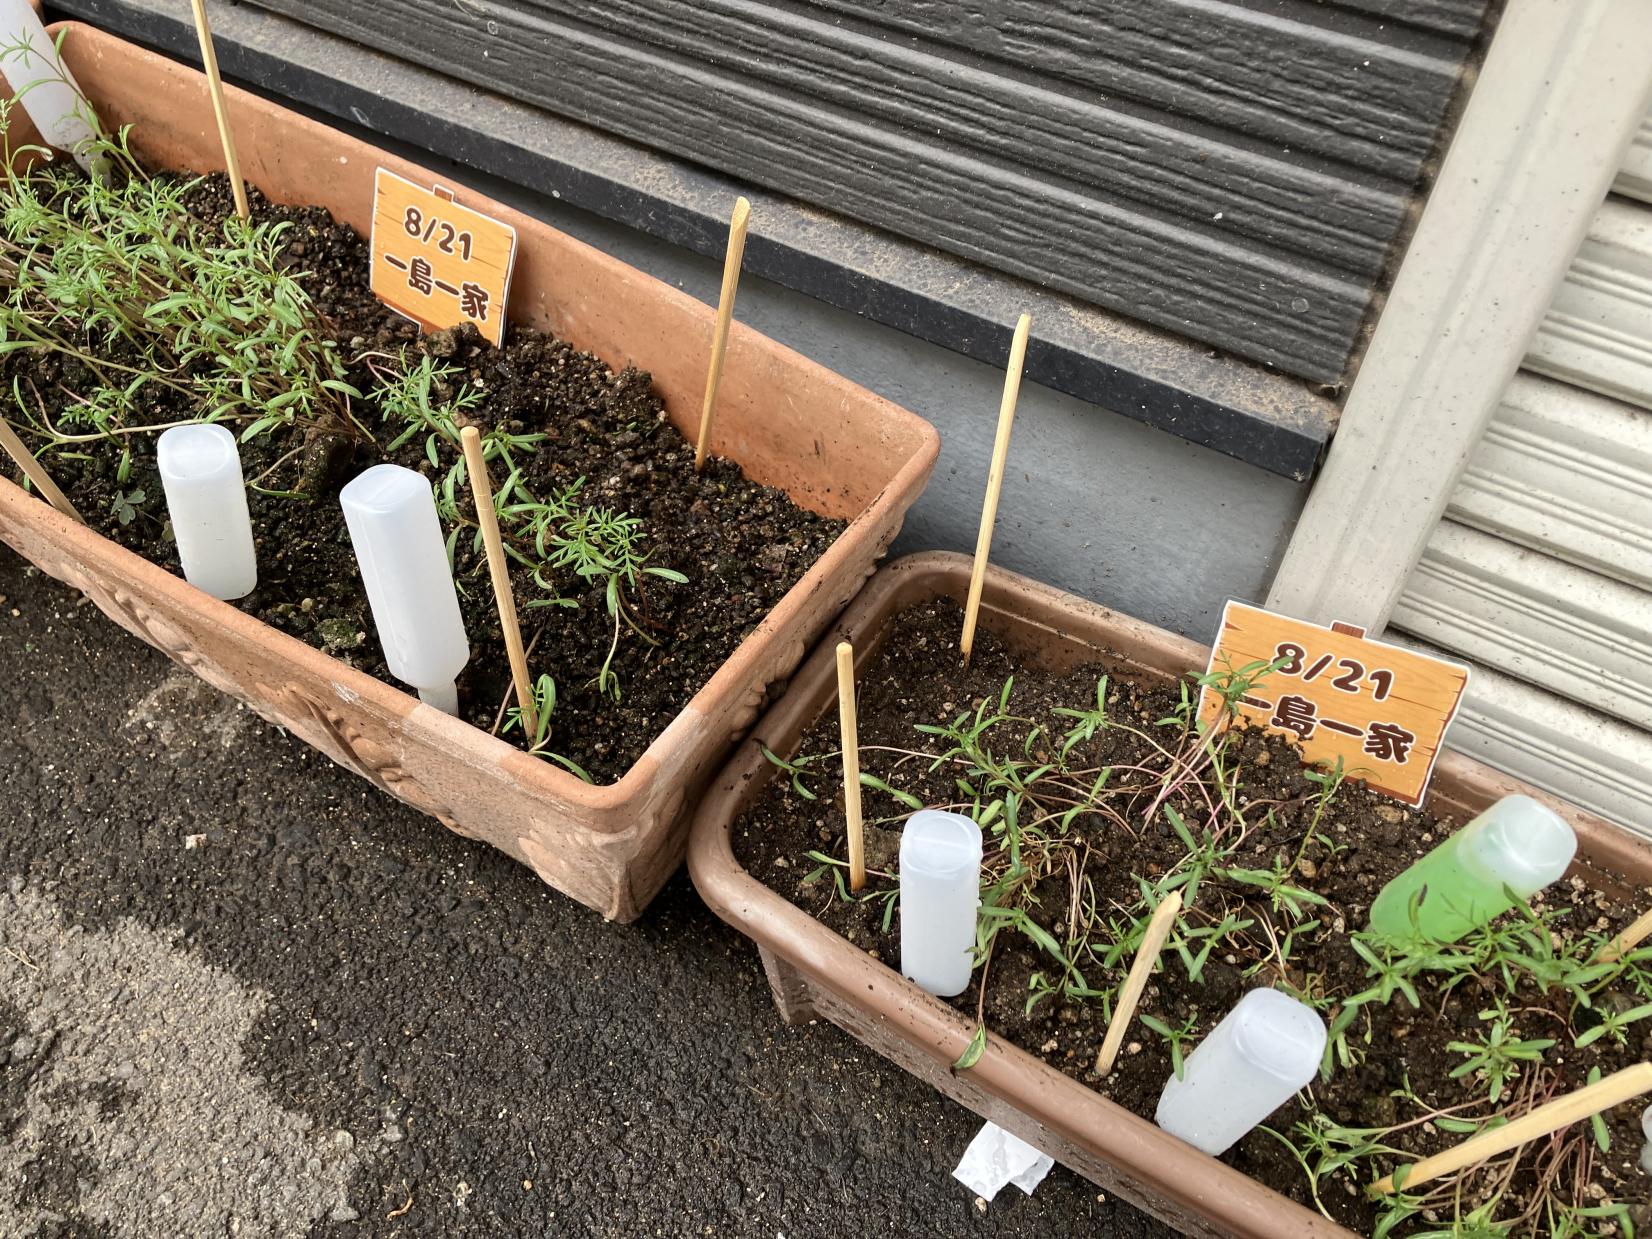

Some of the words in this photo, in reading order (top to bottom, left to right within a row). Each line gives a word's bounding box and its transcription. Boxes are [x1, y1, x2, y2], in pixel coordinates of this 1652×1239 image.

[404, 207, 472, 261] 8/21
[385, 255, 489, 321] 一島一家
[1272, 643, 1393, 701] 8/21
[1234, 692, 1415, 764] 一島一家
